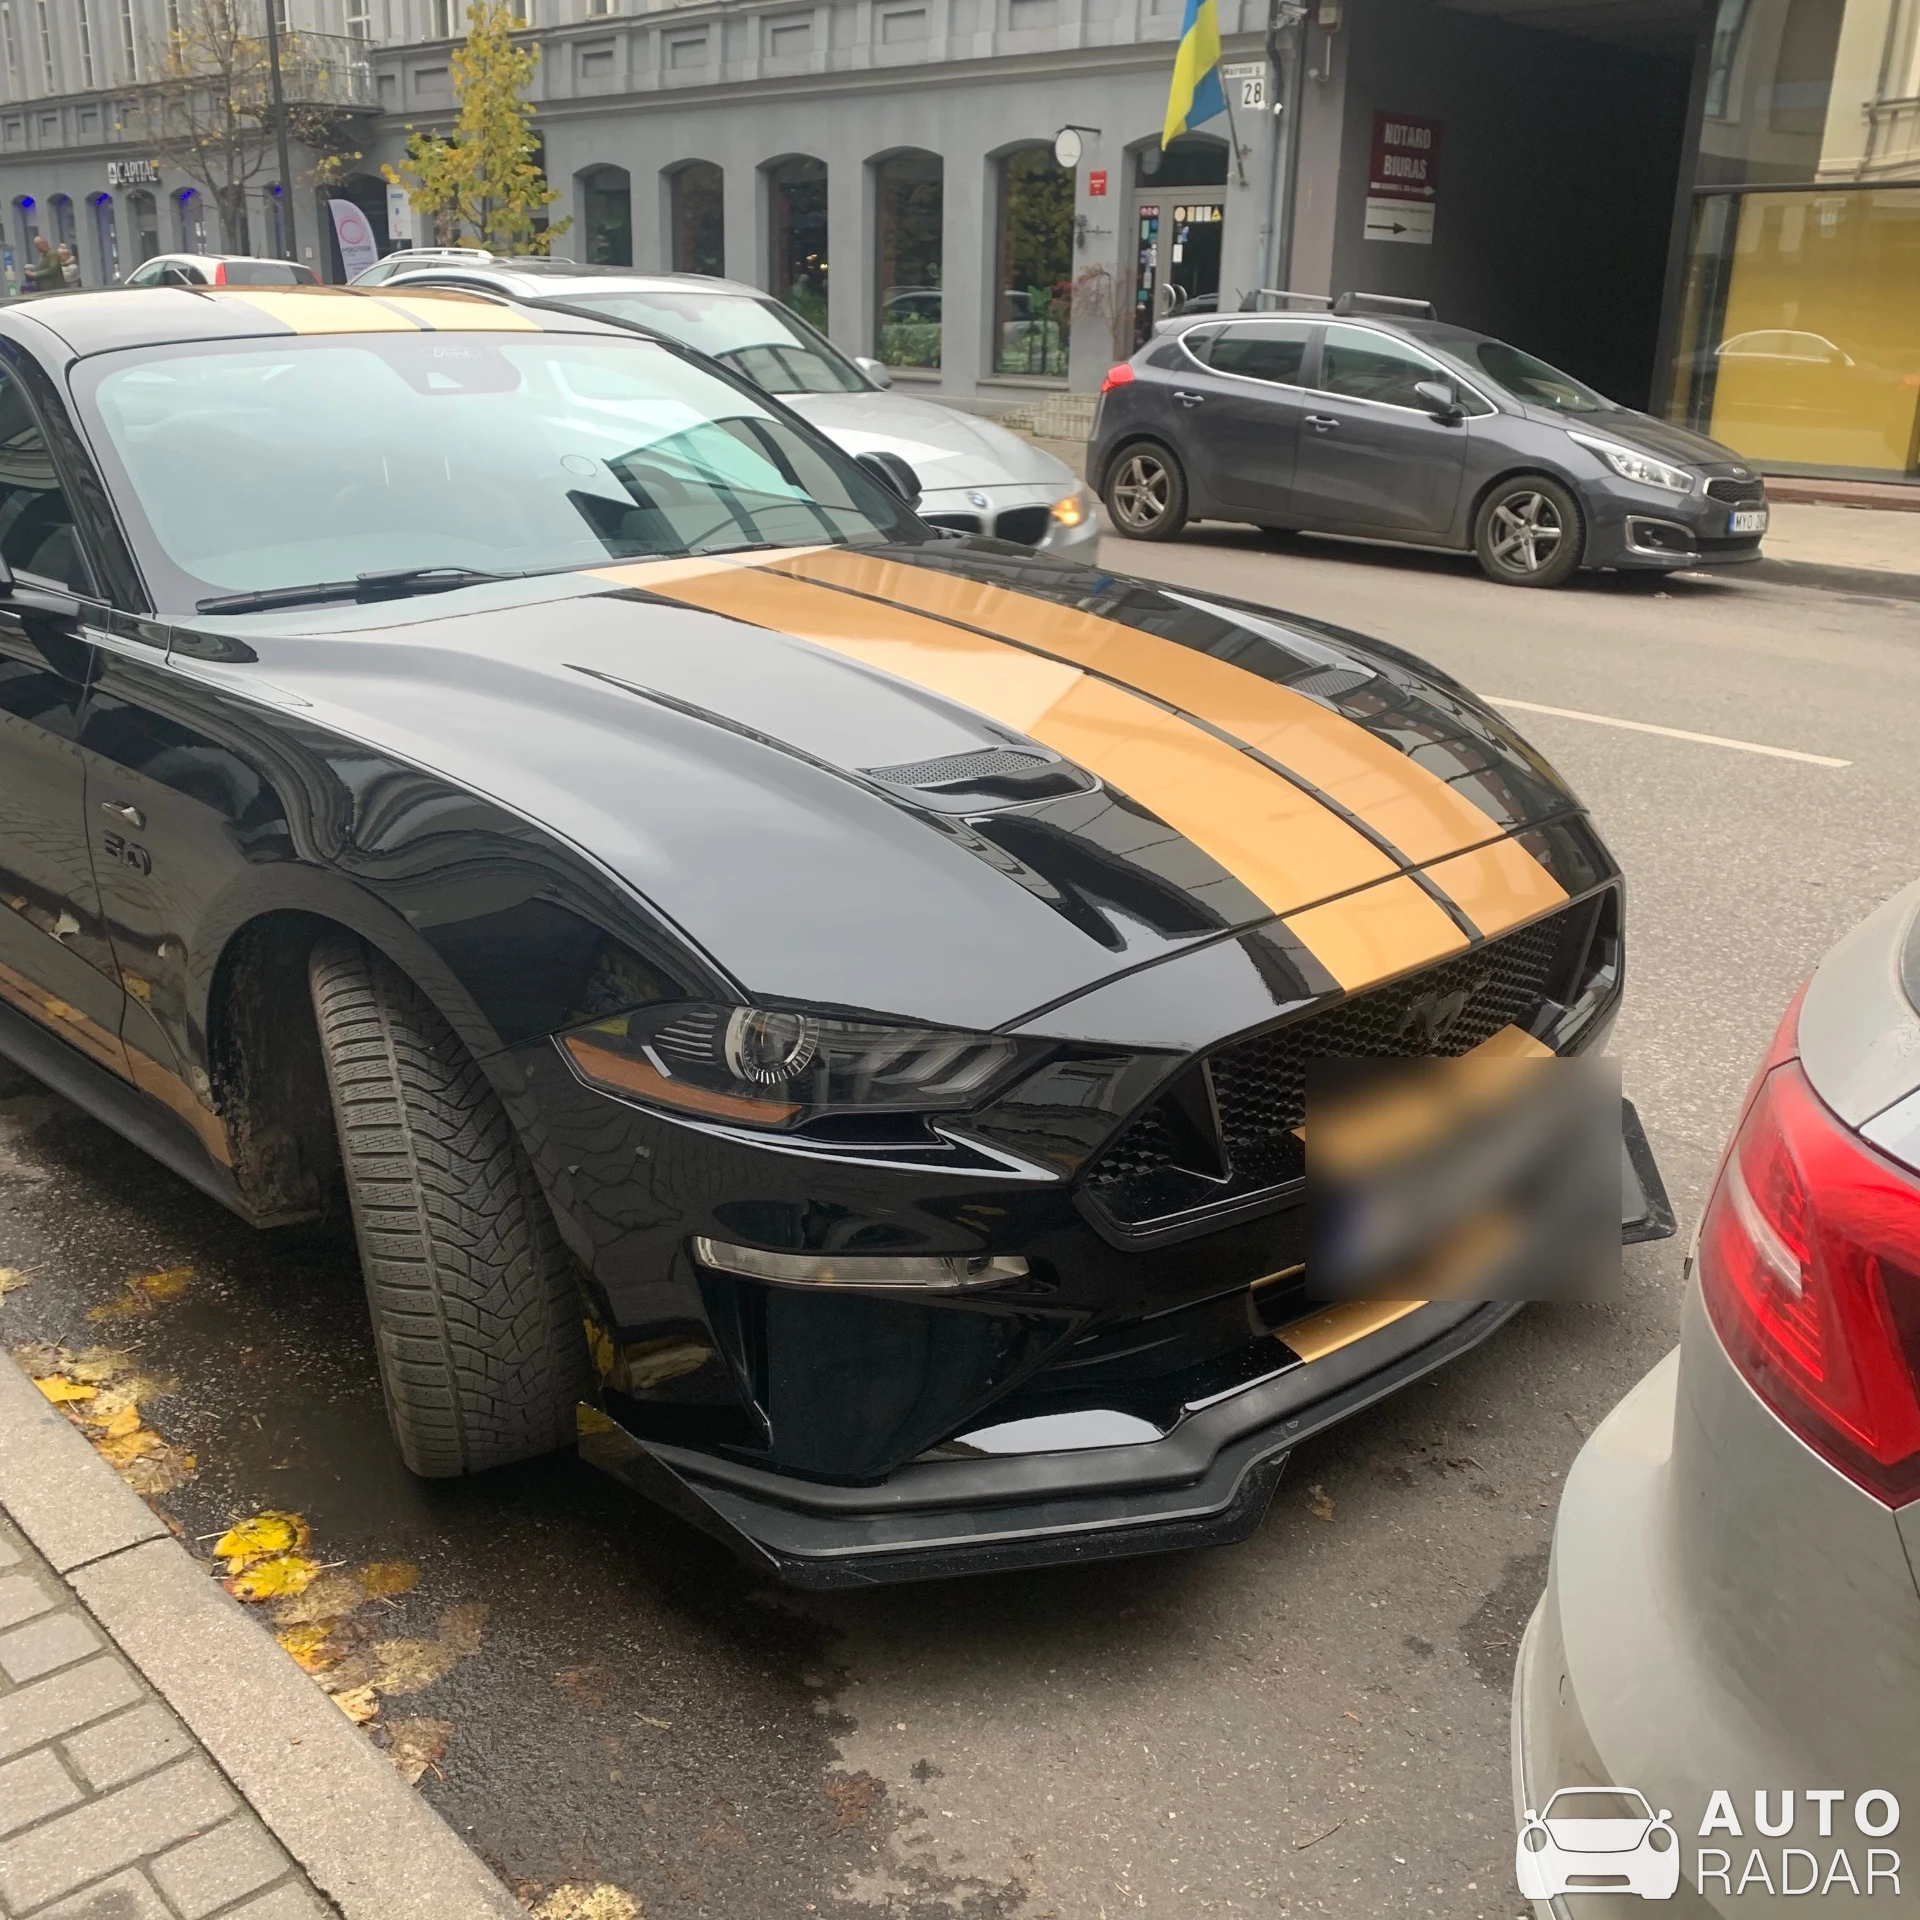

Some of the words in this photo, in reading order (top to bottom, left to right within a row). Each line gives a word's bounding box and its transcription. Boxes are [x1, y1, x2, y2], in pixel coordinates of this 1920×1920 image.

[1244, 82, 1262, 105] 28
[1384, 122, 1432, 149] NOTARO
[117, 160, 157, 183] CAPITAL
[1383, 154, 1428, 180] BIURAS
